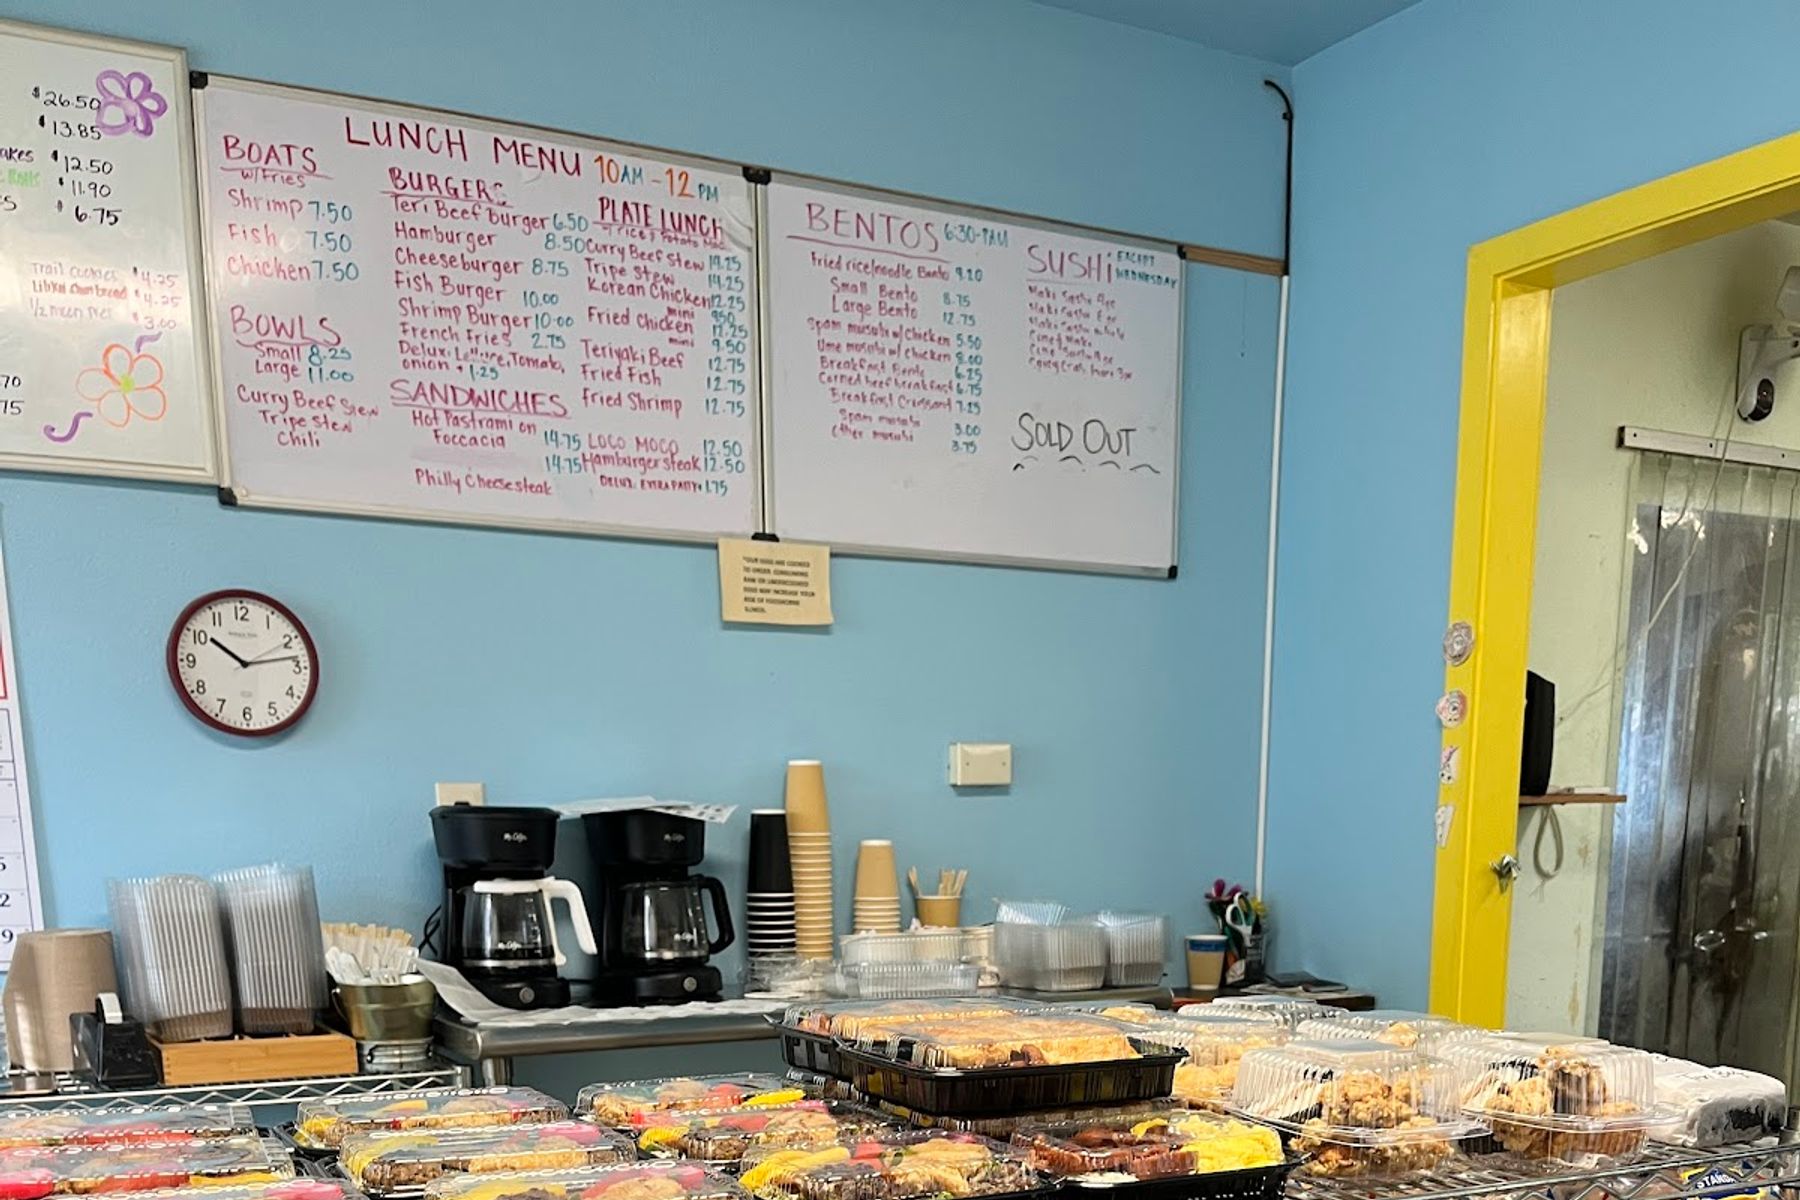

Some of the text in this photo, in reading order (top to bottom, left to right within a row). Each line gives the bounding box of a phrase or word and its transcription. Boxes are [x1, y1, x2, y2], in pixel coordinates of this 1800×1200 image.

[223, 134, 318, 174] BOATS
[345, 116, 469, 162] LUNCH
[493, 136, 582, 177] MENU
[228, 188, 353, 224] Shrimp 7.50
[435, 199, 482, 221] Beef
[598, 196, 723, 239] PLATE LUNCH
[227, 222, 353, 253] Fish 7.50
[395, 220, 585, 253] Hamburger 8.50
[806, 202, 940, 252] BENTOS
[585, 237, 626, 262] Curry
[630, 243, 662, 262] Beef
[227, 252, 360, 282] Chicken 7.50
[395, 247, 569, 281] Cheeseburger 8.75
[585, 257, 627, 281] Tripe
[394, 270, 559, 307] Fish Burger 10.00
[587, 276, 645, 297] Korean
[650, 282, 711, 310] Chicken
[830, 277, 868, 295] Small
[879, 283, 918, 303] Bento
[398, 296, 574, 333] Shrimp Burger 10.00
[587, 305, 630, 326] Fried
[636, 313, 694, 334] Chicken
[832, 295, 872, 321] Large
[878, 300, 918, 319] Bento
[231, 304, 341, 347] BOWLS
[400, 321, 566, 349] French Fries 2.75
[254, 343, 351, 366] Small 8.25
[580, 338, 646, 366] Teriyaki
[650, 346, 685, 369] Beef
[255, 359, 354, 384] Large 11.00
[581, 363, 622, 383] Fried
[627, 366, 662, 388] Fish
[237, 384, 289, 414] Curry
[293, 389, 335, 410] Beef
[390, 378, 568, 417] SANDWICHES
[627, 391, 683, 419] Shrimp
[259, 409, 307, 431] Tripe
[412, 409, 536, 435] Hot Pastrami on
[277, 431, 320, 448] Chili
[434, 429, 505, 448] Foccacia
[581, 452, 659, 475] Hamburger
[415, 467, 461, 494] Philly
[212, 612, 222, 628] 11
[234, 605, 249, 622] 12
[193, 629, 208, 646] 10
[283, 634, 292, 649] 2
[186, 653, 196, 669] 9
[292, 658, 302, 675] 3
[196, 679, 207, 695] 8
[285, 685, 295, 700] 4
[216, 698, 226, 714] 7
[242, 706, 252, 722] 6
[267, 702, 277, 717] 5
